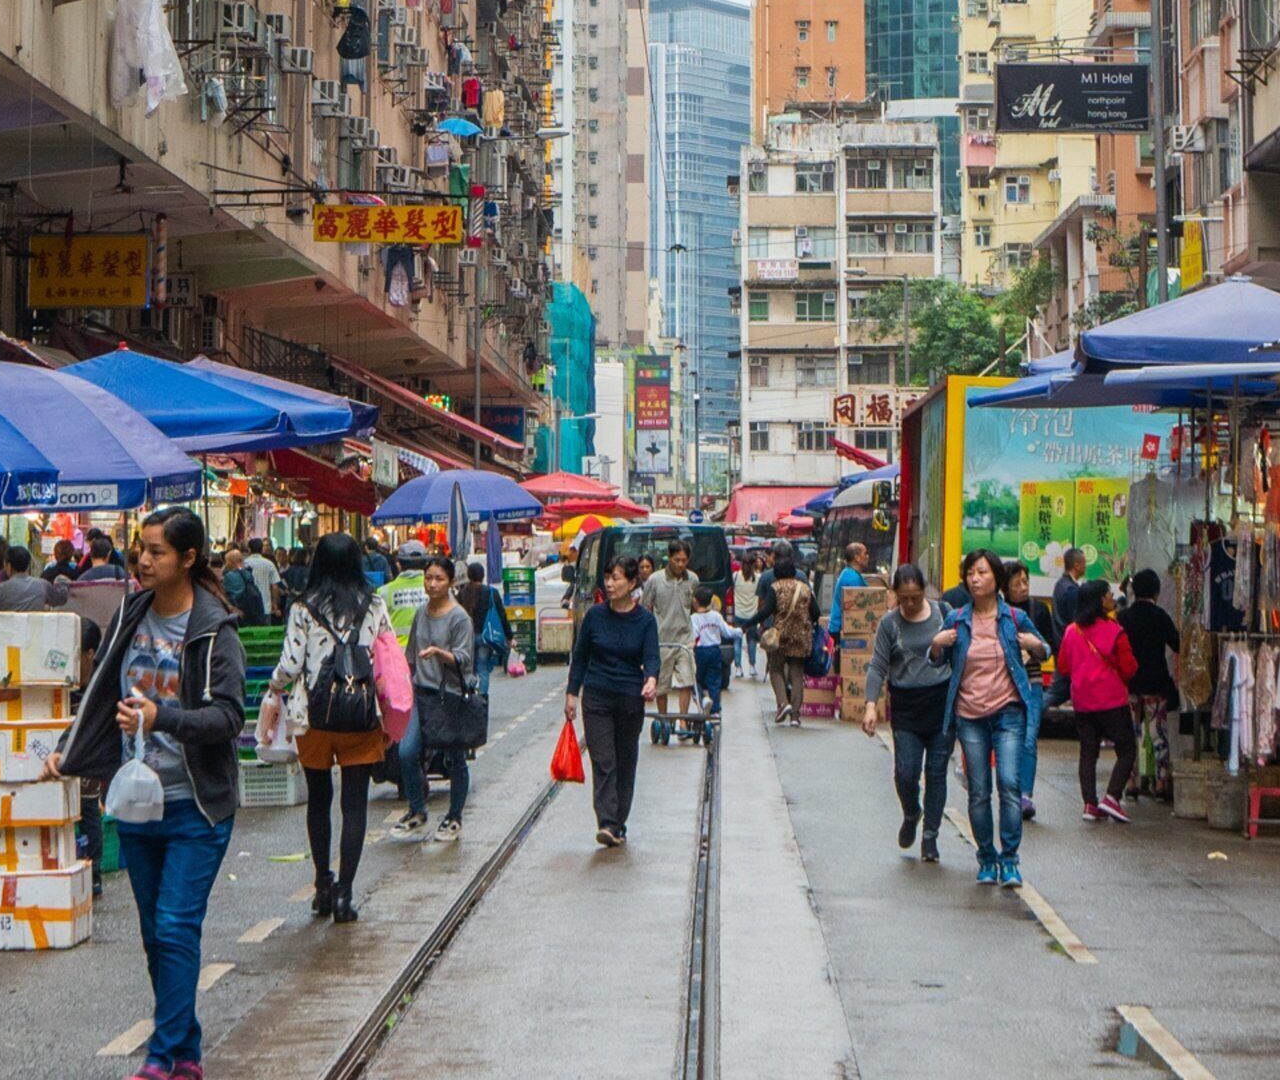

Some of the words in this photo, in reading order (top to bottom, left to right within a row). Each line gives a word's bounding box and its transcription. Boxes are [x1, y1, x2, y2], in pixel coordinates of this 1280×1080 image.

[1080, 73, 1098, 85] M1
[1102, 72, 1133, 84] Hotel
[1087, 96, 1126, 106] northpoint
[1087, 109, 1108, 120] hong
[1109, 109, 1128, 120] kong
[317, 207, 458, 240] 富麗華髮型
[36, 249, 144, 279] 富麗華髮型
[1038, 494, 1053, 542] 無糖茶
[1095, 493, 1111, 544] 無糖茶
